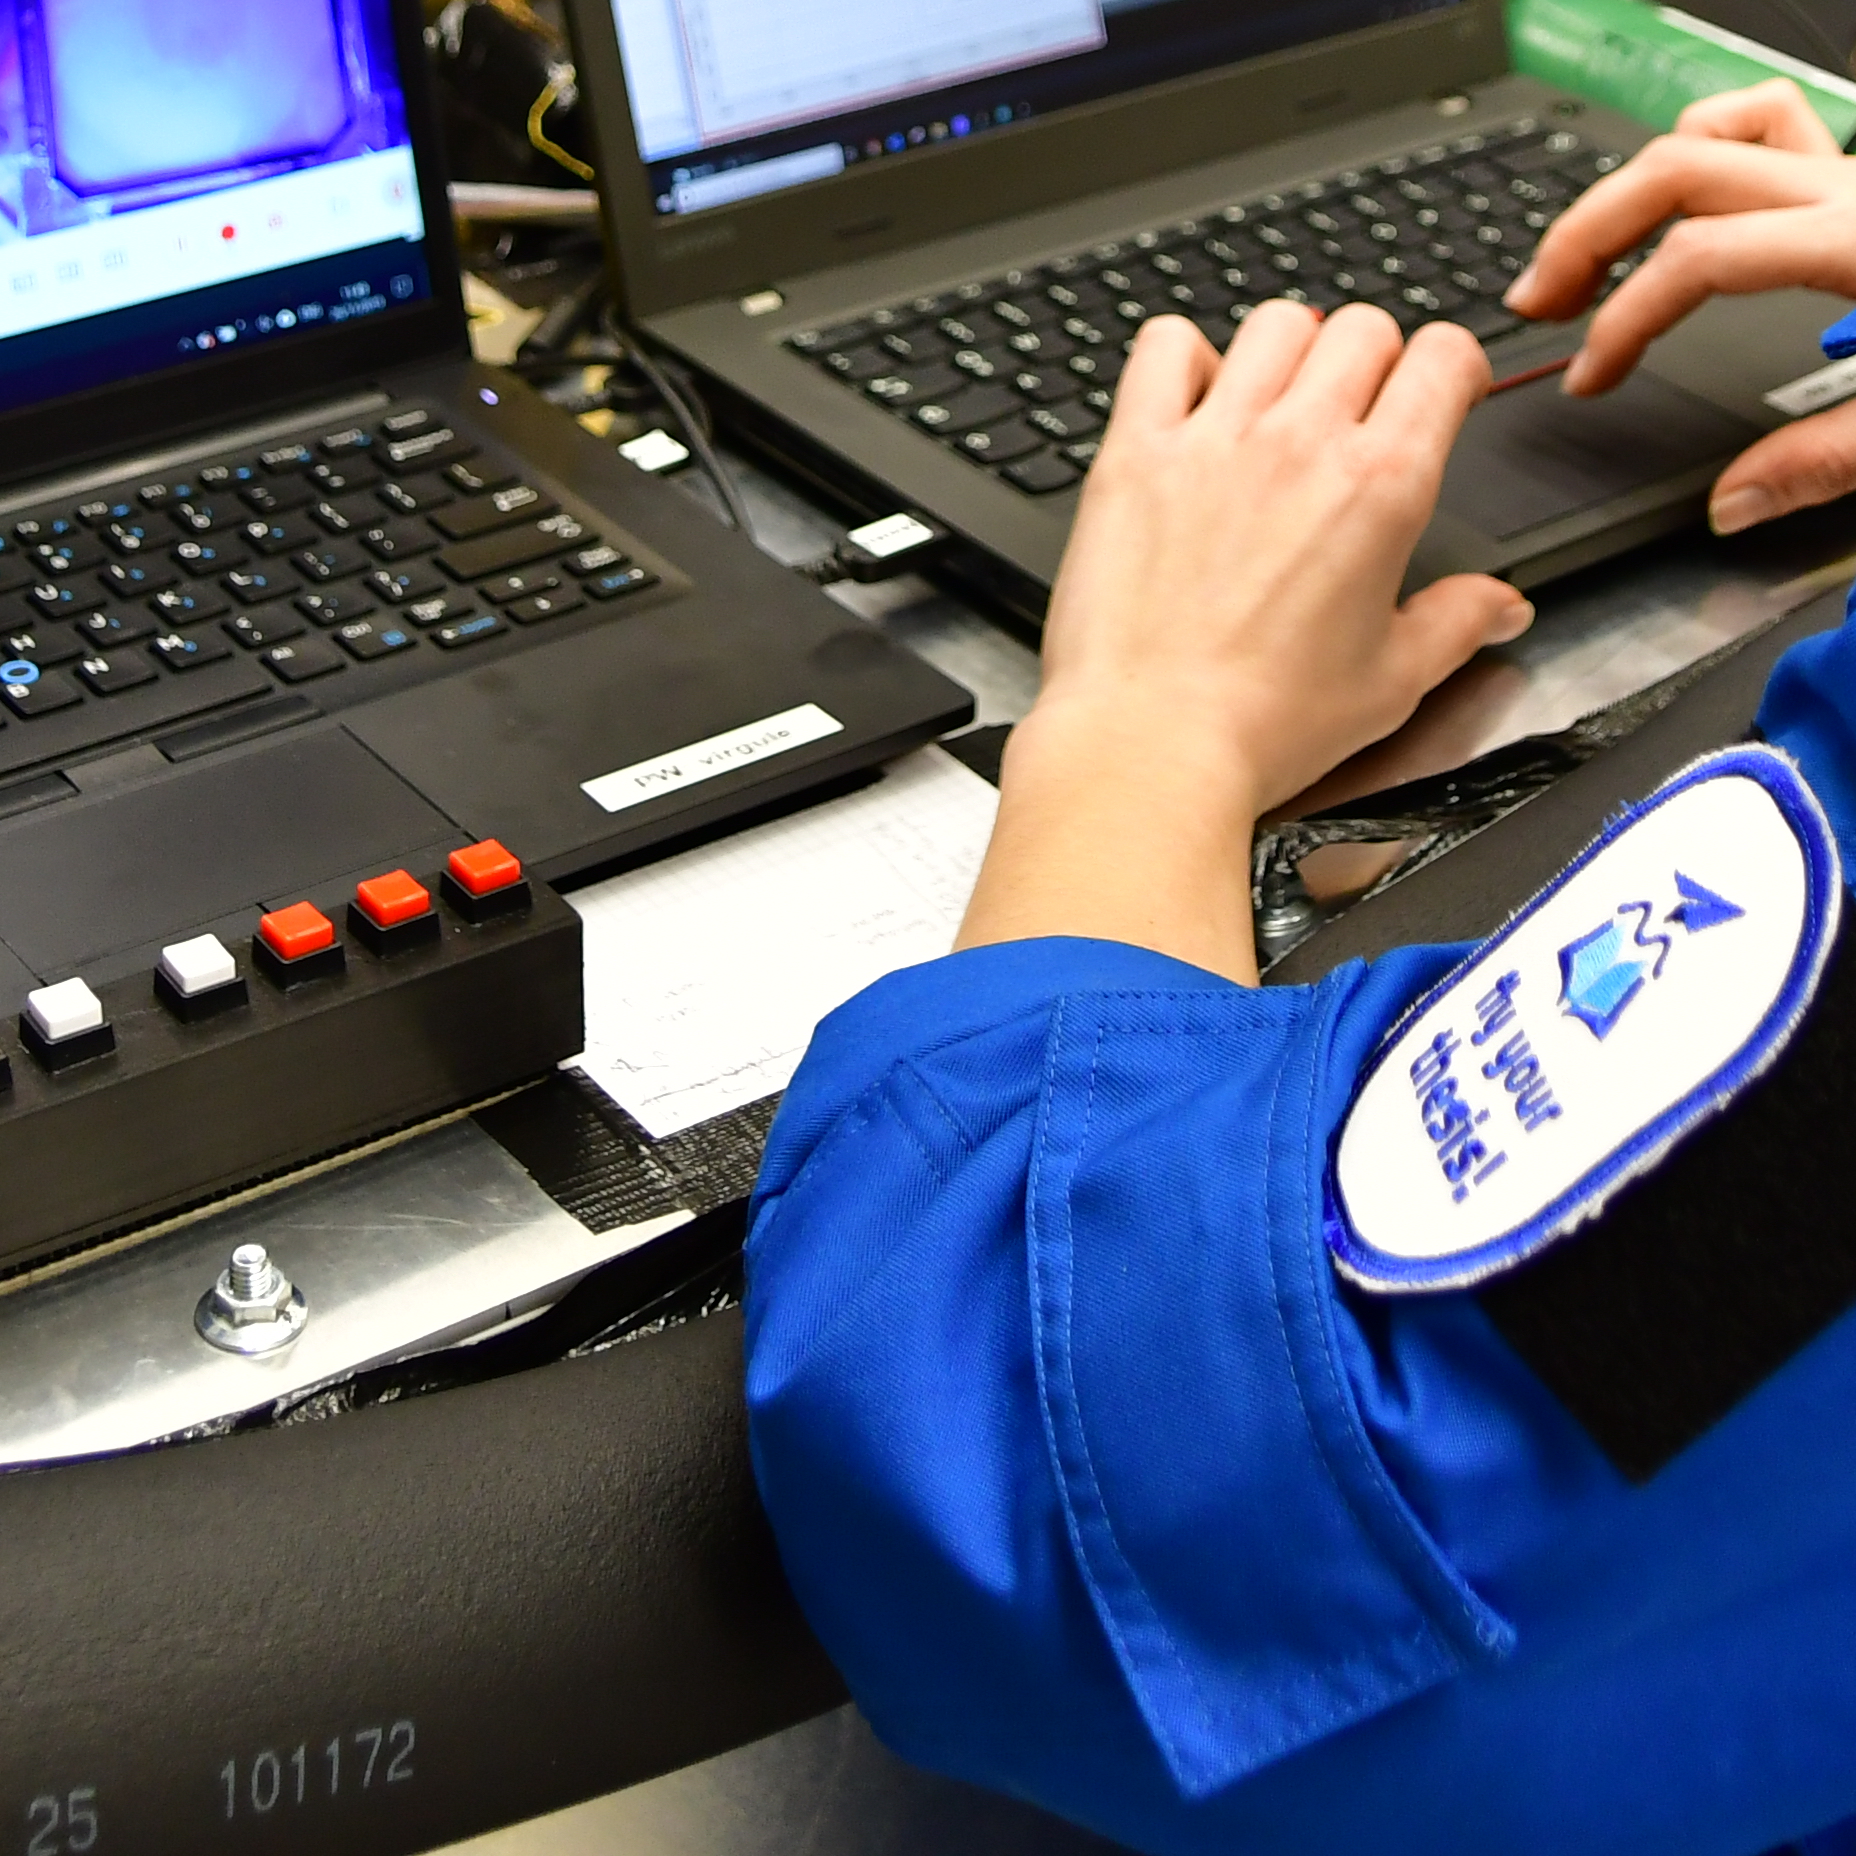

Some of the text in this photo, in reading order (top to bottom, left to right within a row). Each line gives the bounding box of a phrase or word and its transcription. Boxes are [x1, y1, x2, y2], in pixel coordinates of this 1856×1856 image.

[699, 728, 791, 766] virgule
[1409, 1026, 1509, 1205] thesis!
[1469, 969, 1564, 1134] fly your
[27, 1787, 98, 1856] 25
[219, 1719, 417, 1820] 101172
